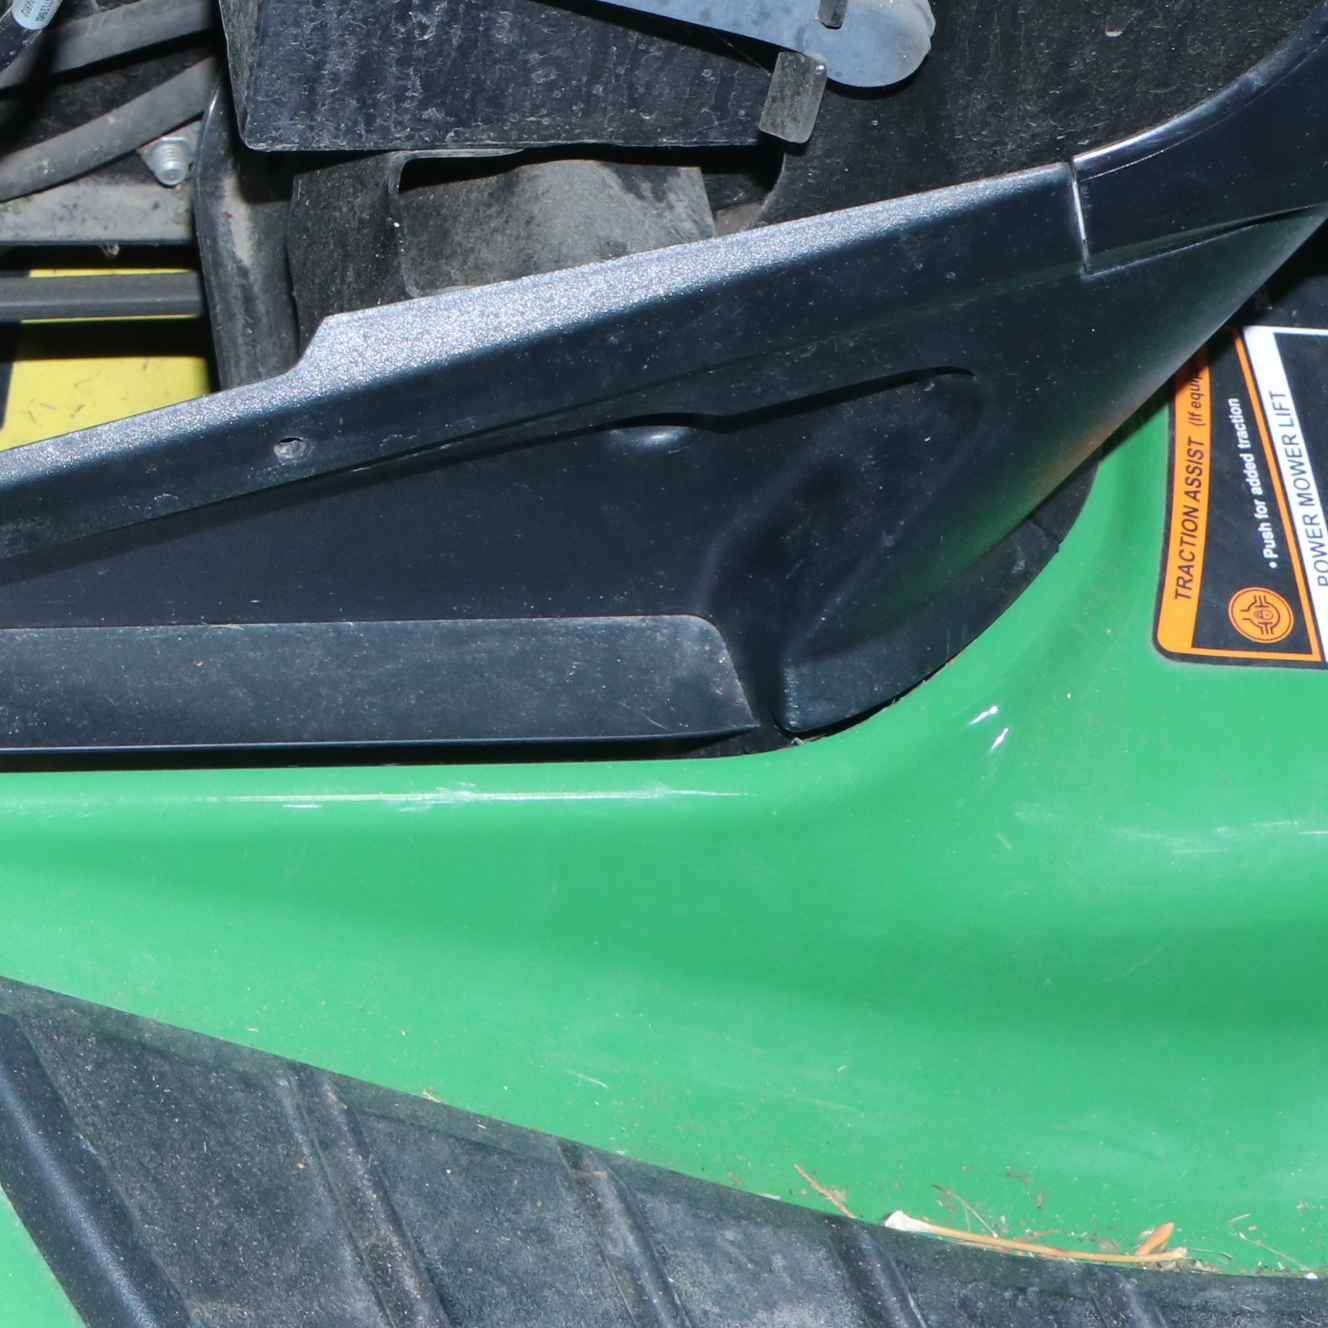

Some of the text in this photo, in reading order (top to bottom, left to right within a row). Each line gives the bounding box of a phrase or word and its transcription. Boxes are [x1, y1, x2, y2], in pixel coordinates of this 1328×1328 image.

[1175, 507, 1200, 600] TRACTION
[1188, 437, 1206, 503] ASSIST
[1228, 398, 1277, 558] Push for added traction
[1269, 391, 1328, 586] POWER MOWER LIFT
